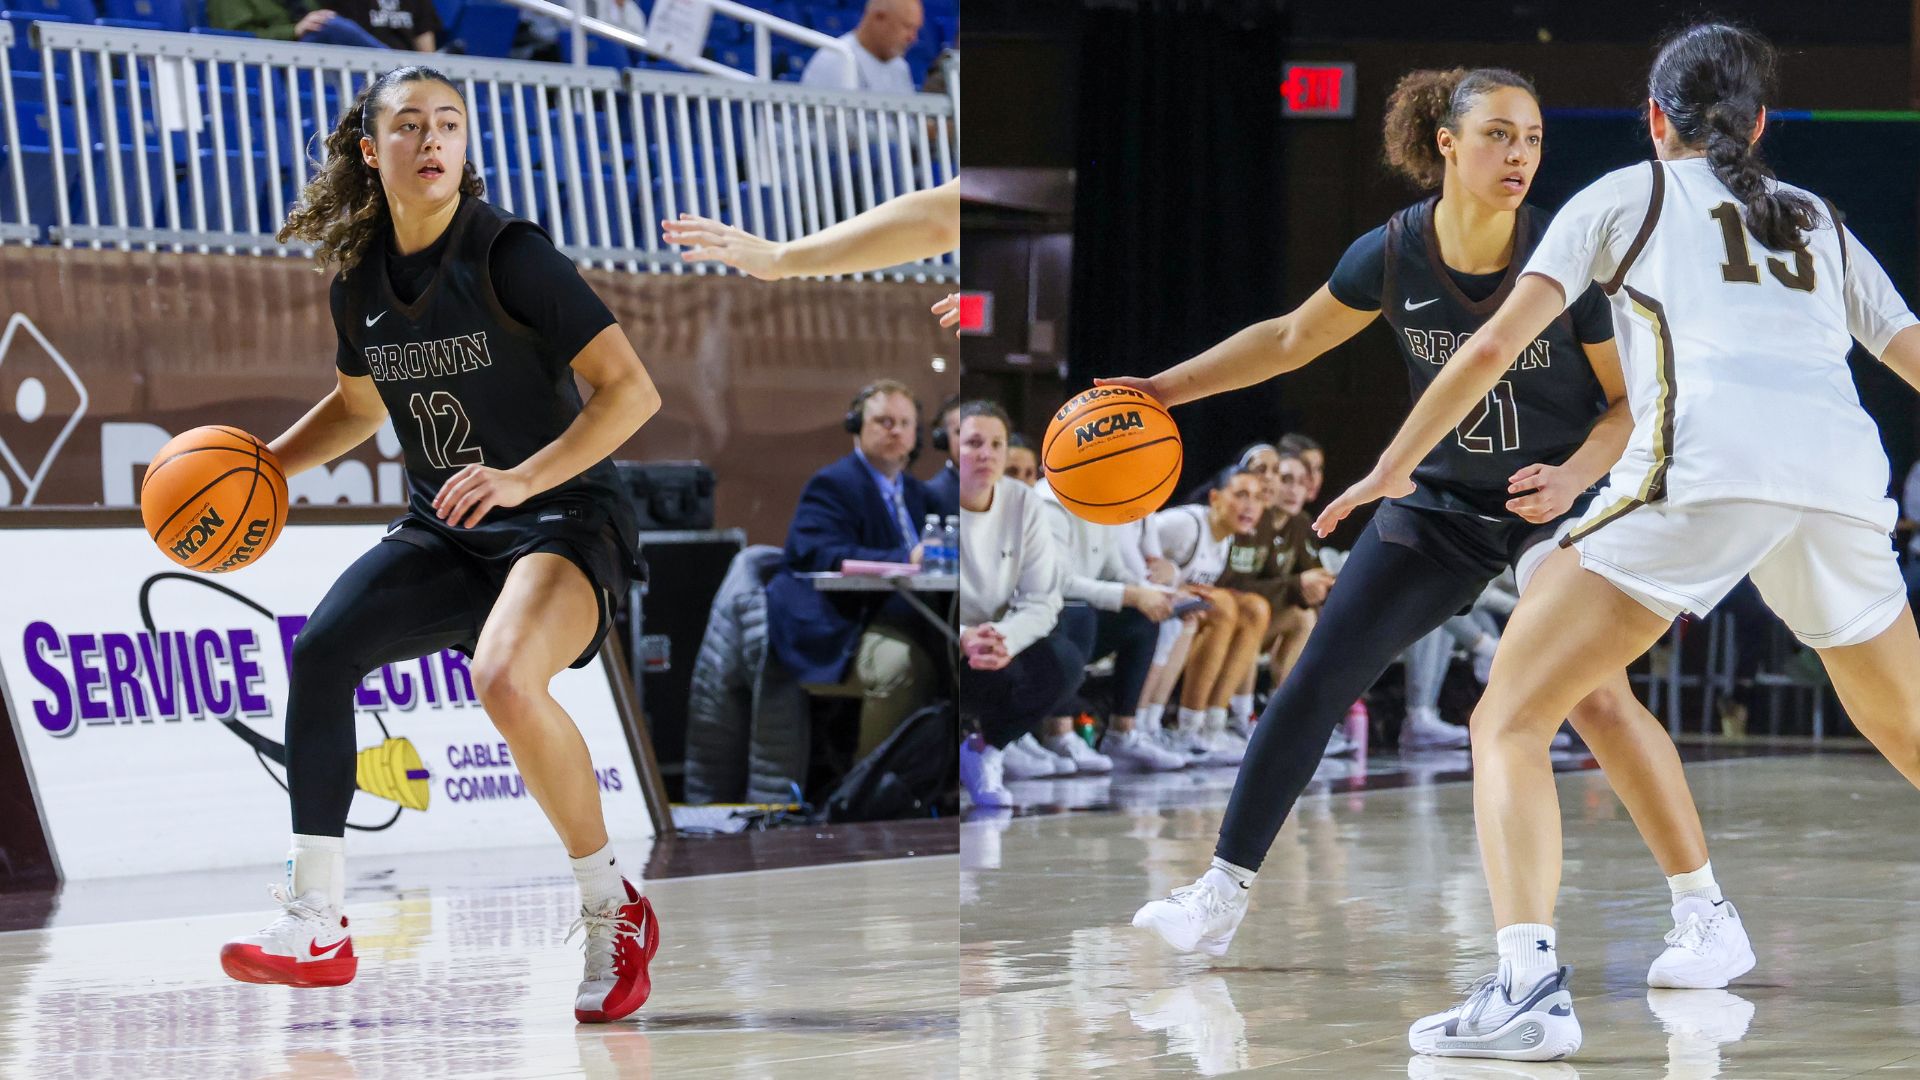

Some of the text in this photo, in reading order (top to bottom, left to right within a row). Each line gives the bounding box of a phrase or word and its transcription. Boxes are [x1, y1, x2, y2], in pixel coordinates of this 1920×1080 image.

[365, 331, 492, 381] BROWN
[1404, 327, 1550, 371] BRN
[409, 391, 484, 468] 12
[1074, 411, 1146, 448] NCAA
[170, 507, 225, 561] NCAA
[208, 518, 270, 573] Wilso
[23, 620, 271, 736] SERVICE
[447, 743, 511, 769] CABLE
